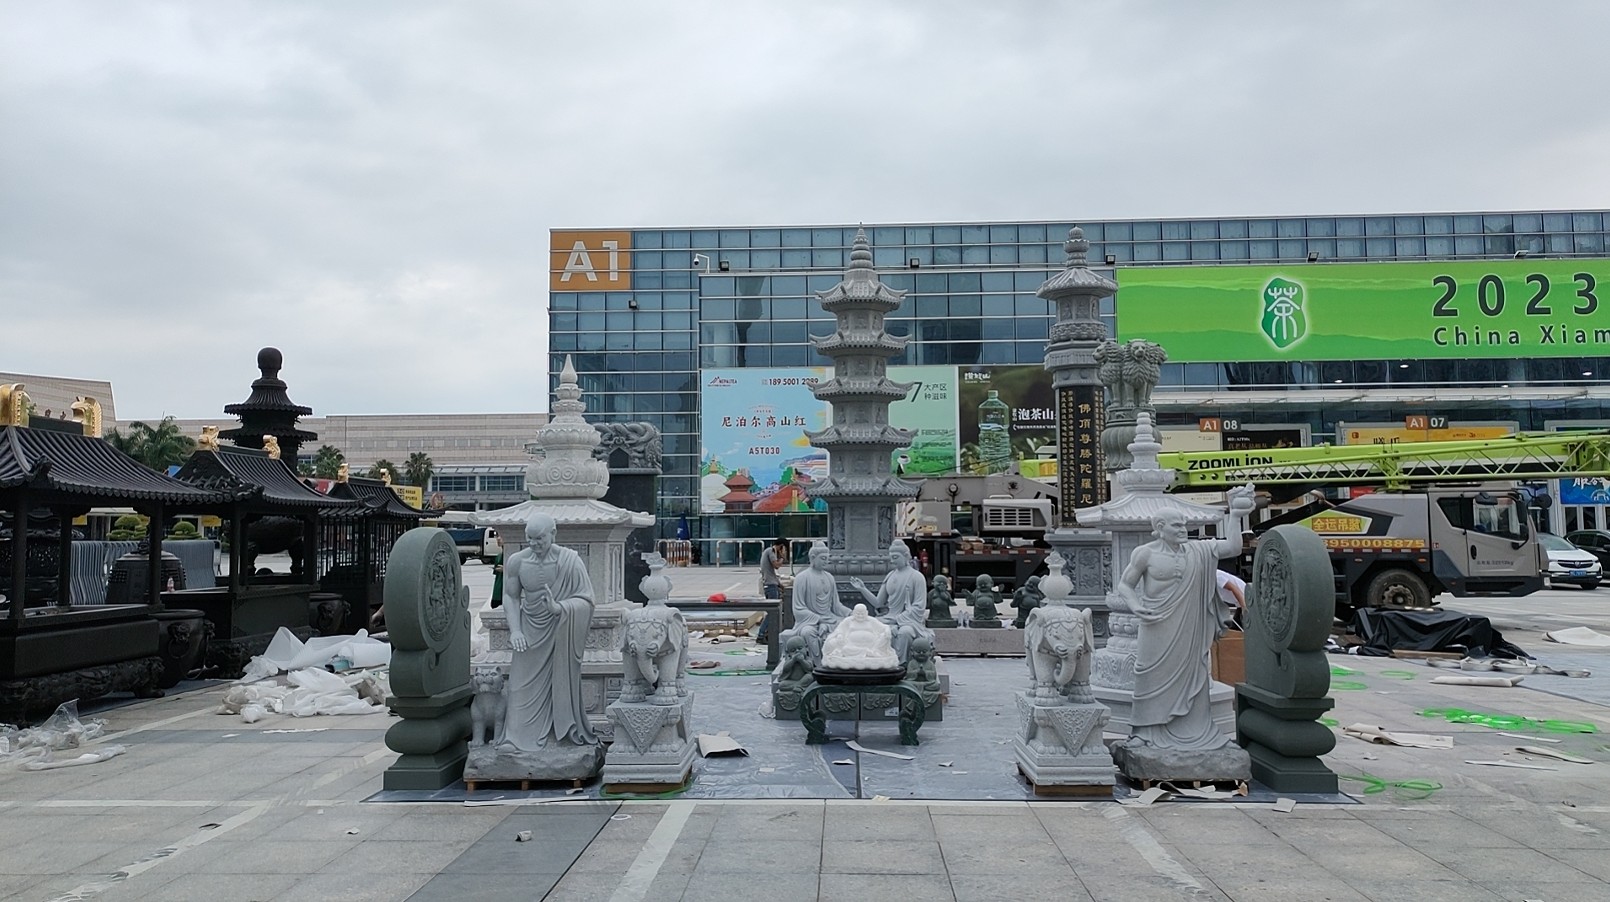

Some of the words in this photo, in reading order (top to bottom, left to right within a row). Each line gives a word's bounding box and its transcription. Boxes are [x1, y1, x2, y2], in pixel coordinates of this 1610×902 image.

[560, 240, 618, 282] A1
[1431, 272, 1599, 318] 2023
[1433, 325, 1520, 347] China
[1539, 323, 1610, 345] Xiam
[769, 378, 781, 386] 189
[783, 378, 799, 386] 5001
[1018, 407, 1057, 420] 泡茶山
[721, 415, 807, 428] 尼泊尔高山红
[1203, 420, 1218, 431] A1
[1223, 420, 1239, 430] 08
[1410, 417, 1425, 428] A1
[1430, 417, 1445, 428] 07
